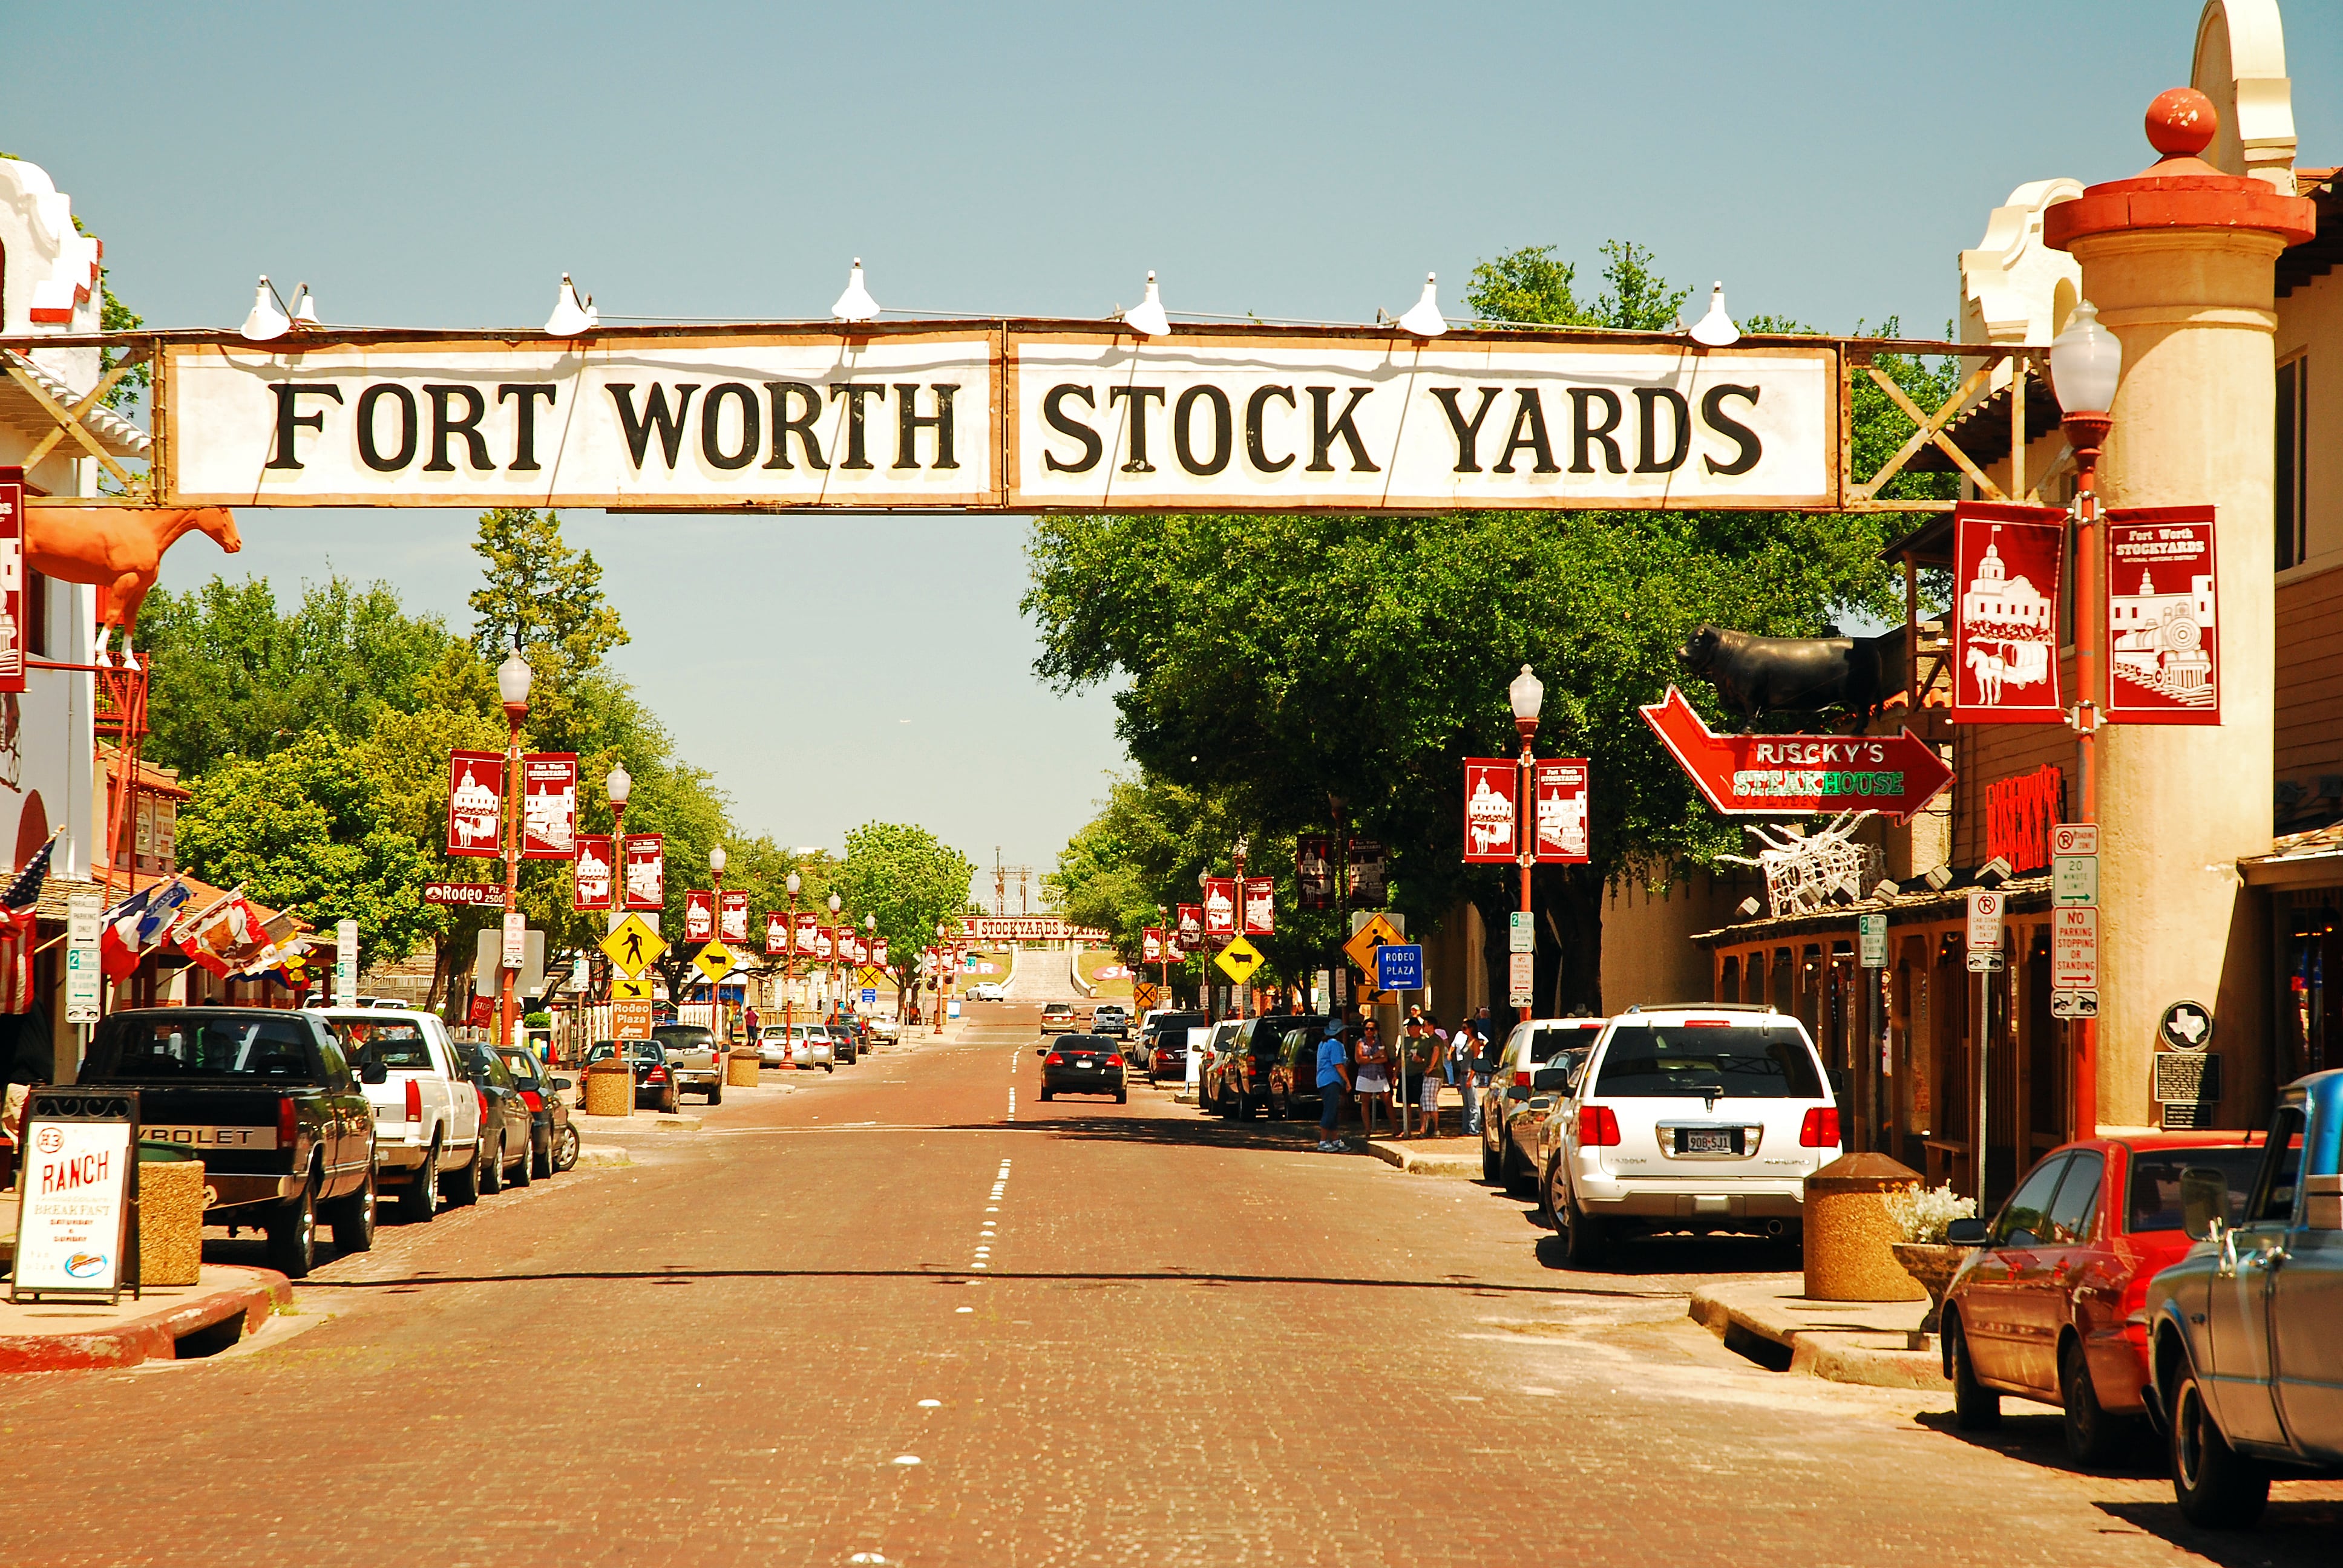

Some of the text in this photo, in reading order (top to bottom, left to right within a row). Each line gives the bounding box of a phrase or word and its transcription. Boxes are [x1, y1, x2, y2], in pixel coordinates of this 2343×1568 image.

[265, 382, 1762, 477] FORT WORTH STOCK YARDS
[2129, 528, 2194, 541] Fort Worth
[2116, 541, 2205, 555] STOCKYARDS
[1757, 742, 1884, 763] RISCKY'S
[1733, 770, 1904, 796] STEAKHOUSE
[2069, 861, 2083, 871] 20
[442, 885, 482, 900] Rodeo
[1513, 915, 1518, 926] 2
[2067, 912, 2085, 924] NO
[981, 921, 1058, 935] STOCKYARDS
[1861, 920, 1867, 932] 2
[2060, 927, 2092, 937] PARKING
[2057, 939, 2094, 948] STOPPING
[70, 952, 78, 967] 2
[1385, 953, 1415, 961] RODEO
[2071, 950, 2082, 959] OR
[1386, 966, 1415, 975] PLAZA
[2057, 961, 2095, 970] STANDING
[475, 1001, 490, 1011] STOP
[614, 1004, 649, 1013] Rodeo
[617, 1014, 646, 1024] Plaza
[42, 1150, 110, 1195] RANCH
[34, 1204, 111, 1216] BREAKFAST
